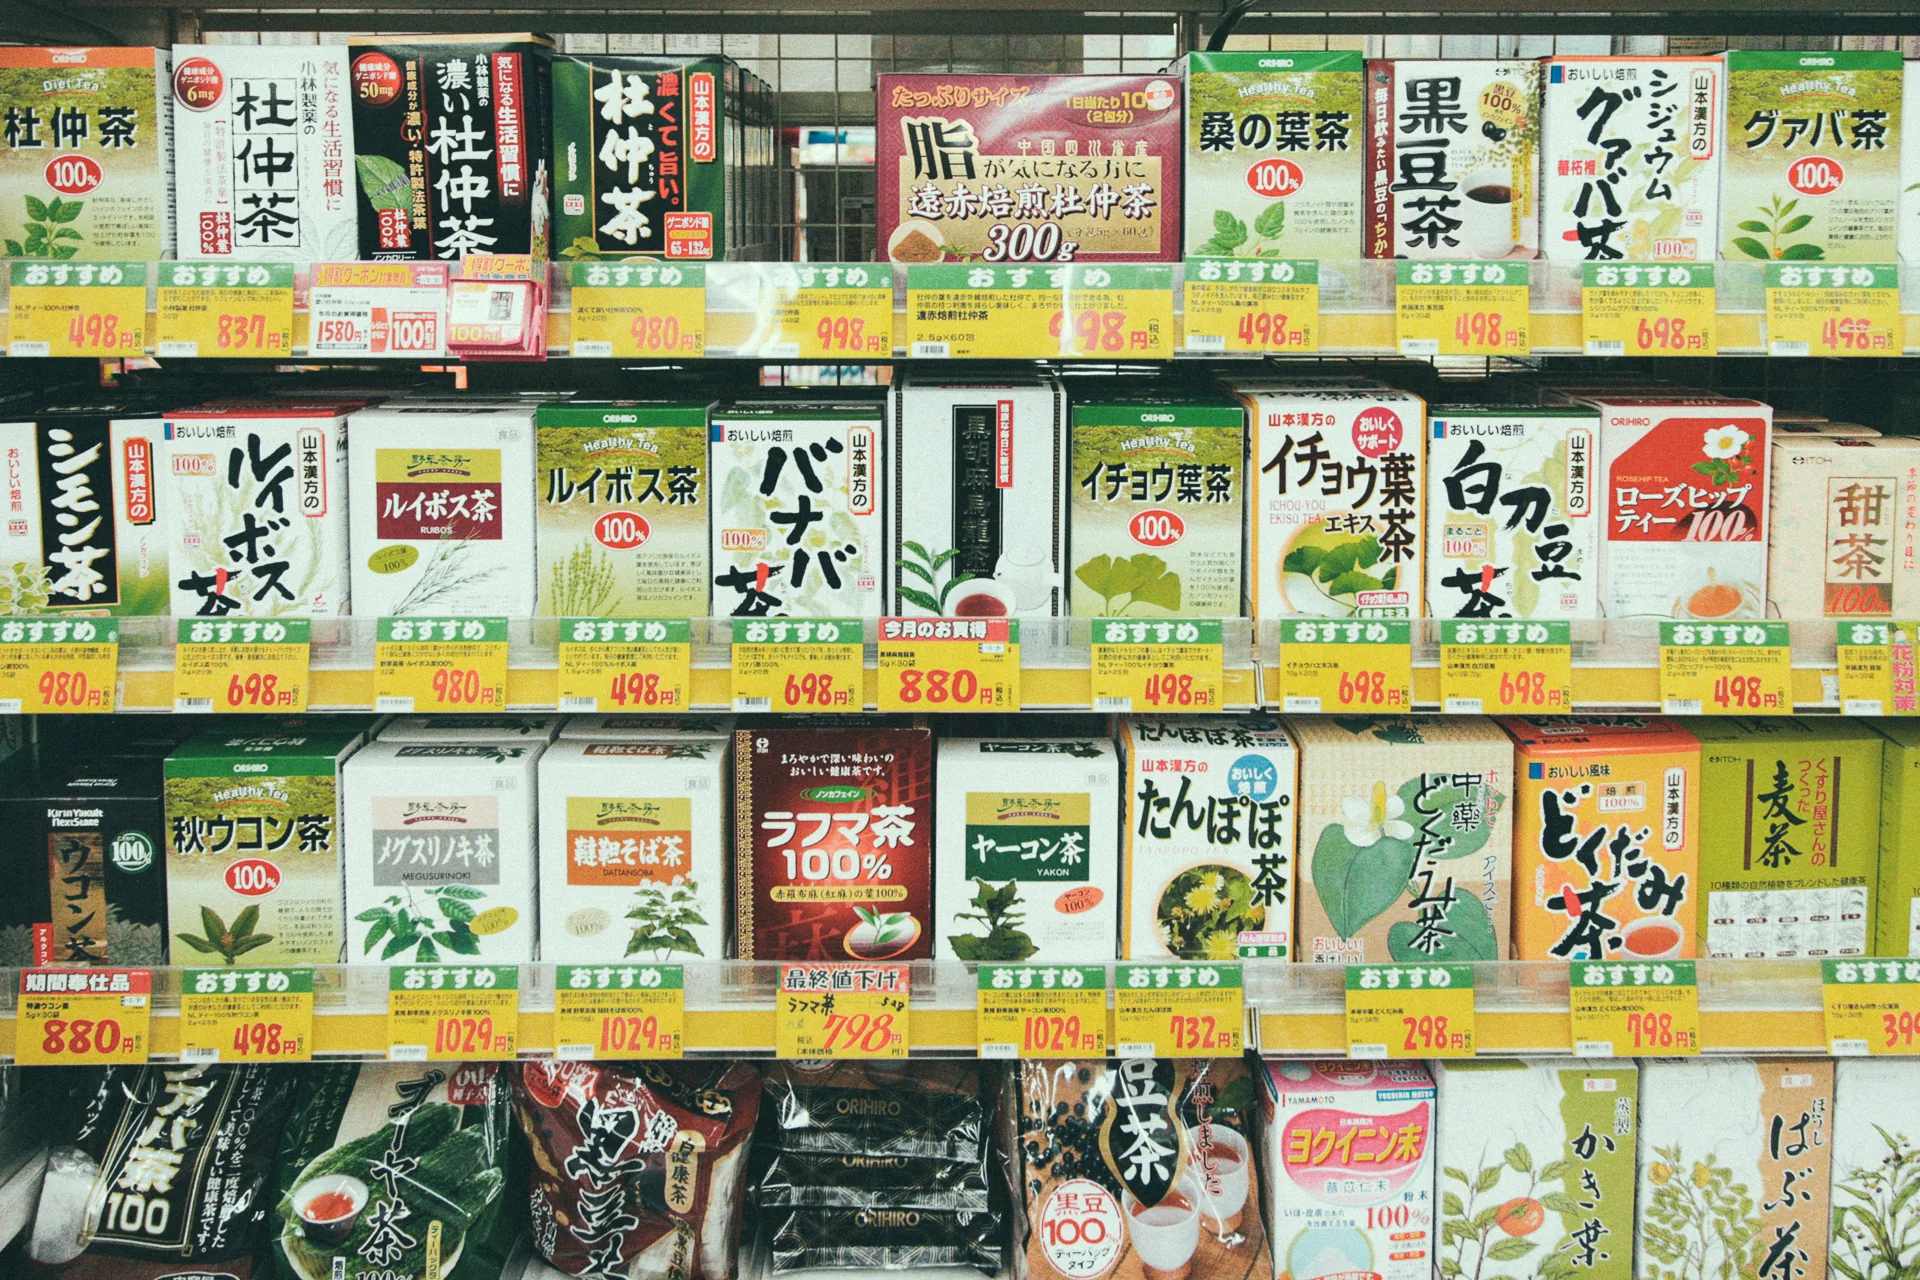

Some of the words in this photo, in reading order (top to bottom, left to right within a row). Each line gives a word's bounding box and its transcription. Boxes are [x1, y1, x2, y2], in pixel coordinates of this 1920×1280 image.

[1258, 58, 1294, 68] ORIHIRO
[475, 54, 488, 107] 小林製薬の
[1567, 68, 1638, 81] おいしい焙煎
[43, 79, 71, 93] Diet
[76, 79, 101, 92] Tea
[359, 83, 394, 99] 50mg
[892, 85, 1031, 108] たっぷりサイズ
[1238, 81, 1290, 99] Healthy
[1293, 80, 1316, 99] Tea
[1780, 80, 1830, 97] Healthy
[1834, 80, 1857, 97] Tea
[301, 61, 318, 135] 小林製薬の
[694, 80, 711, 157] 山本漢方の
[1693, 77, 1708, 151] 山本漢方の
[3, 106, 138, 149] 杜仲茶
[322, 60, 344, 212] 気になる生活習慣に
[496, 56, 522, 197] 気になる生活習慣に
[1200, 111, 1352, 152] 桑の葉茶
[1645, 69, 1678, 201] シジュウム
[1744, 110, 1889, 150] グァバ茶
[656, 72, 681, 205] 濃くて旨い。
[1018, 139, 1149, 157] 中国四川省産
[233, 81, 299, 243] 杜仲茶
[425, 60, 498, 258] 濃い杜仲茶
[594, 68, 656, 246] 杜仲茶
[906, 121, 977, 181] 脂
[984, 160, 1146, 180] が気になる方に
[1389, 77, 1469, 249] 黒豆茶
[53, 161, 98, 188] 100%
[1255, 165, 1299, 190] 100%
[1796, 163, 1840, 188] 100%
[908, 182, 1157, 220] 遠赤焙煎杜仲茶
[666, 217, 710, 229] ゲニポシド酸
[983, 223, 1078, 263] 300g
[25, 264, 123, 286] おすすめ
[774, 265, 868, 288] おすすめ
[967, 267, 1111, 288] おすすめ
[1411, 263, 1506, 284] おすすめ
[1596, 266, 1691, 287] おすすめ
[603, 415, 637, 423] ORIHIRO
[1141, 414, 1175, 422] ORIHIRO
[1269, 413, 1336, 427] 山本漢方の
[1611, 417, 1650, 426] ORIHIRO
[176, 425, 236, 439] おいしい焙煎
[727, 429, 793, 442] おいしい焙煎
[1450, 424, 1524, 436] おいしい焙煎
[583, 437, 633, 454] Healthy
[637, 438, 659, 454] Tea
[1121, 436, 1171, 451] Healthy
[1174, 437, 1196, 452] Tea
[8, 448, 22, 513] おいしい焙煎
[128, 443, 147, 518] 山本漢方の
[303, 435, 319, 509] 山本漢方の
[853, 433, 867, 507] 山本漢方の
[1570, 436, 1585, 509] 山本漢方の
[547, 466, 699, 507] ルイボス茶
[1081, 461, 1233, 504] イチョウ葉茶
[382, 489, 498, 523] ルイボス茶
[1615, 483, 1753, 510] ローズヒップ
[48, 429, 110, 601] シモン茶
[1270, 514, 1299, 524] EKISU
[1303, 514, 1322, 524] TEA
[1325, 514, 1376, 534] エキス
[1615, 509, 1676, 534] ティー
[420, 526, 453, 535] RUIBOS
[602, 518, 646, 543] 100%
[1138, 516, 1180, 541] 100%
[1446, 527, 1482, 536] まるごと
[1833, 482, 1890, 579] 甜茶
[1, 622, 96, 642] おすすめ
[190, 621, 286, 642] おすすめ
[573, 621, 667, 642] おすすめ
[746, 621, 840, 642] おすすめ
[884, 619, 988, 640] 今月のお買得
[1295, 622, 1389, 642] おすすめ
[1455, 623, 1549, 644] おすすめ
[899, 669, 993, 705] 880円
[781, 753, 894, 765] まろやかで深い味わいの
[1141, 760, 1208, 772] 山本漢方の
[790, 766, 887, 777] おいしい健康茶です。
[1549, 765, 1610, 778] おいしい風味
[213, 786, 263, 803] Healthy
[267, 786, 289, 803] Tea
[815, 789, 860, 799] ノンカフェイン
[1666, 774, 1680, 843] 山本漢方の
[1755, 760, 1807, 868] 麦茶
[1811, 758, 1827, 867] くすり屋さんの
[173, 814, 332, 854] 秋ウコン茶
[761, 804, 916, 849] ラフマ茶
[378, 833, 496, 867] メグスリノキ茶
[972, 832, 1086, 865] ヤーコン茶
[603, 869, 654, 877] DATTANSOBA
[782, 850, 892, 880] 100%
[1037, 868, 1069, 877] YAKON
[1408, 772, 1458, 954] どくだみ茶
[234, 866, 276, 890] 100%
[402, 872, 471, 881] MEGUSURINOKI
[59, 840, 100, 961] ウコン茶
[26, 973, 131, 992] 期間奉仕品
[195, 972, 290, 993] おすすめ
[404, 968, 496, 989] おすすめ
[786, 969, 898, 990] 最終値下げ
[992, 968, 1084, 989] おすすめ
[1128, 967, 1220, 988] おすすめ
[1583, 965, 1675, 986] おすすめ
[42, 1019, 134, 1054] 880円
[837, 1100, 901, 1116] ORIHIRO
[1288, 1096, 1335, 1104] YAMAMOTO
[1287, 1123, 1423, 1164] ヨクイニン末
[1057, 1192, 1108, 1216] 黒豆
[1560, 1125, 1615, 1267] かき葉
[855, 1211, 920, 1229] ORIHIRO
[1068, 1259, 1096, 1270] タイプ
